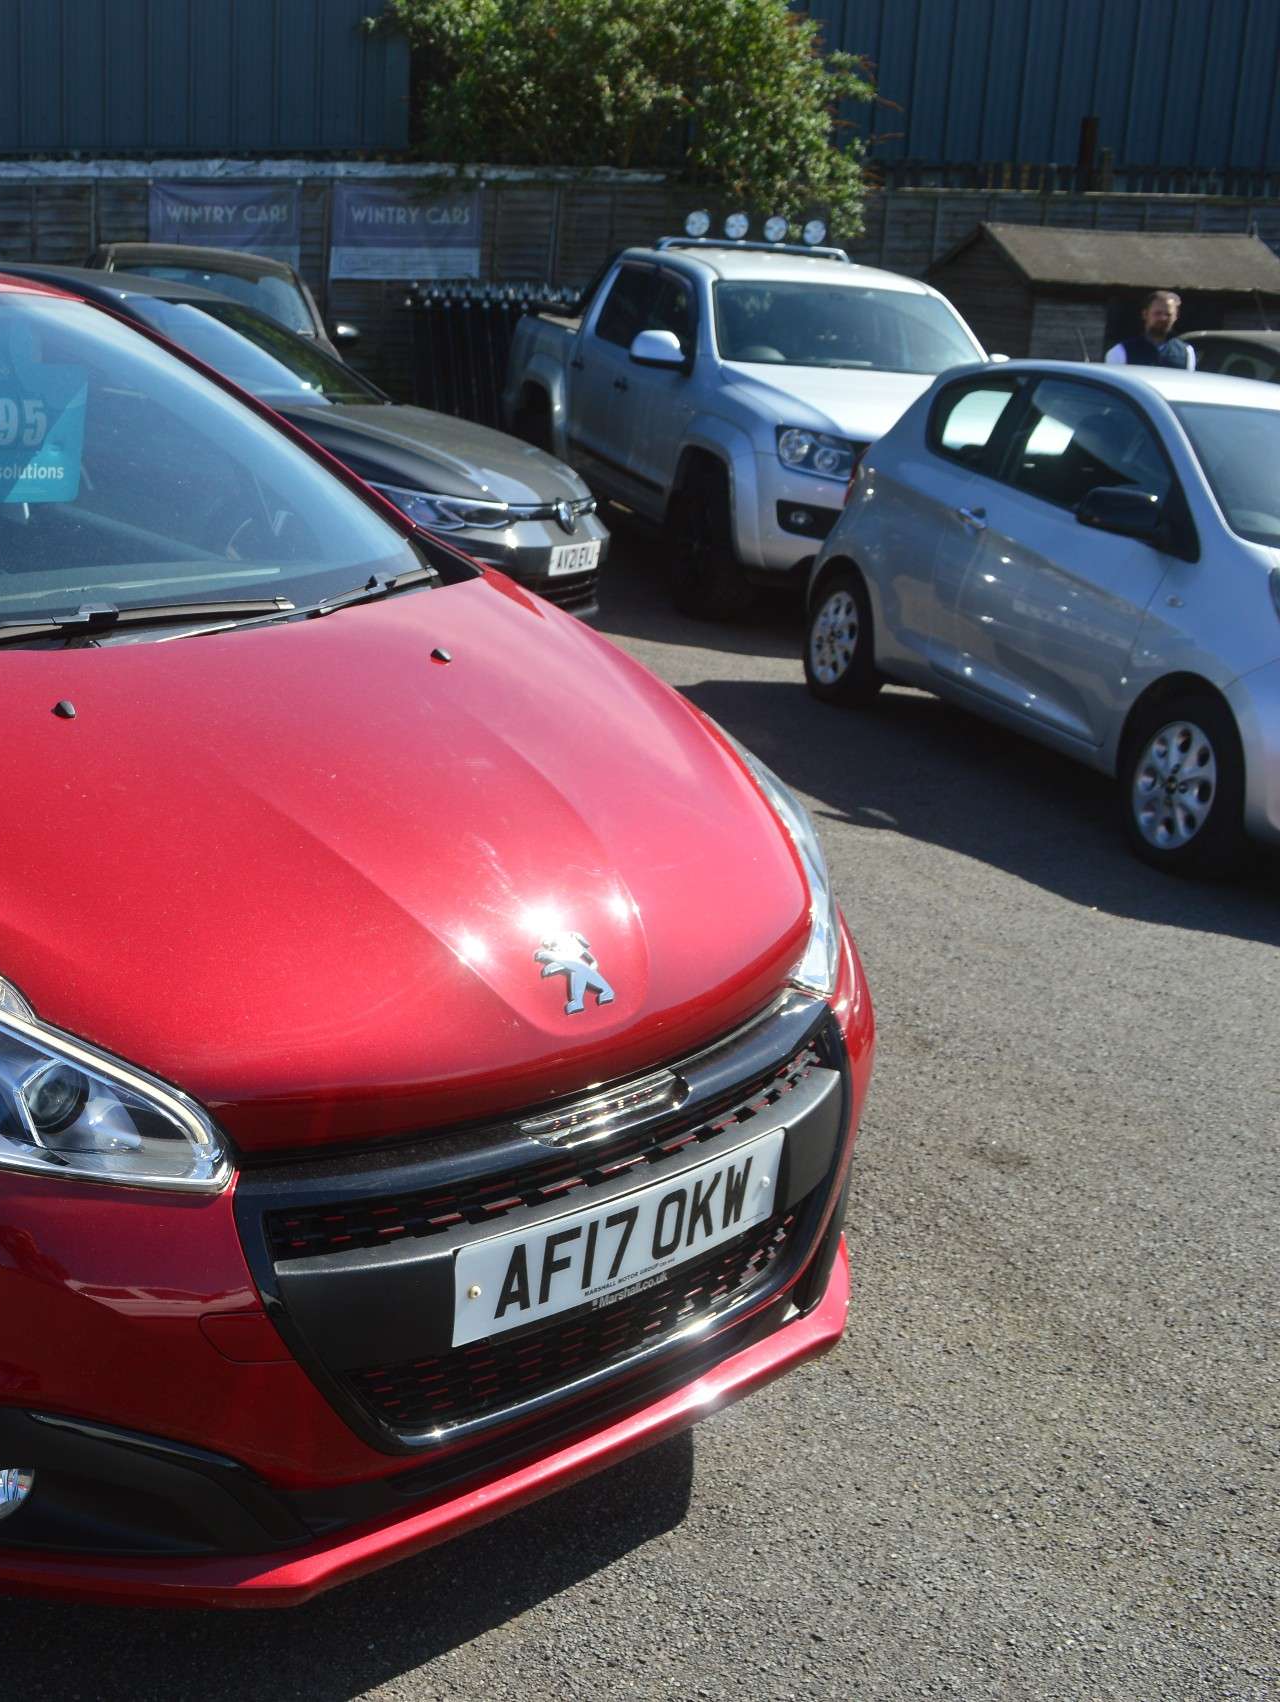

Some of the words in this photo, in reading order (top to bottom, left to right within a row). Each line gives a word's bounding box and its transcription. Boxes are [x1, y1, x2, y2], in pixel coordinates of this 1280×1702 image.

[166, 204, 238, 224] WINTRY
[243, 204, 288, 223] CARS
[351, 206, 419, 225] WINTRY
[425, 206, 470, 225] CARS
[493, 1205, 640, 1320] AF17
[651, 1155, 754, 1260] OKW
[584, 1281, 617, 1297] MARSHALL
[618, 1271, 639, 1284] MOTOR
